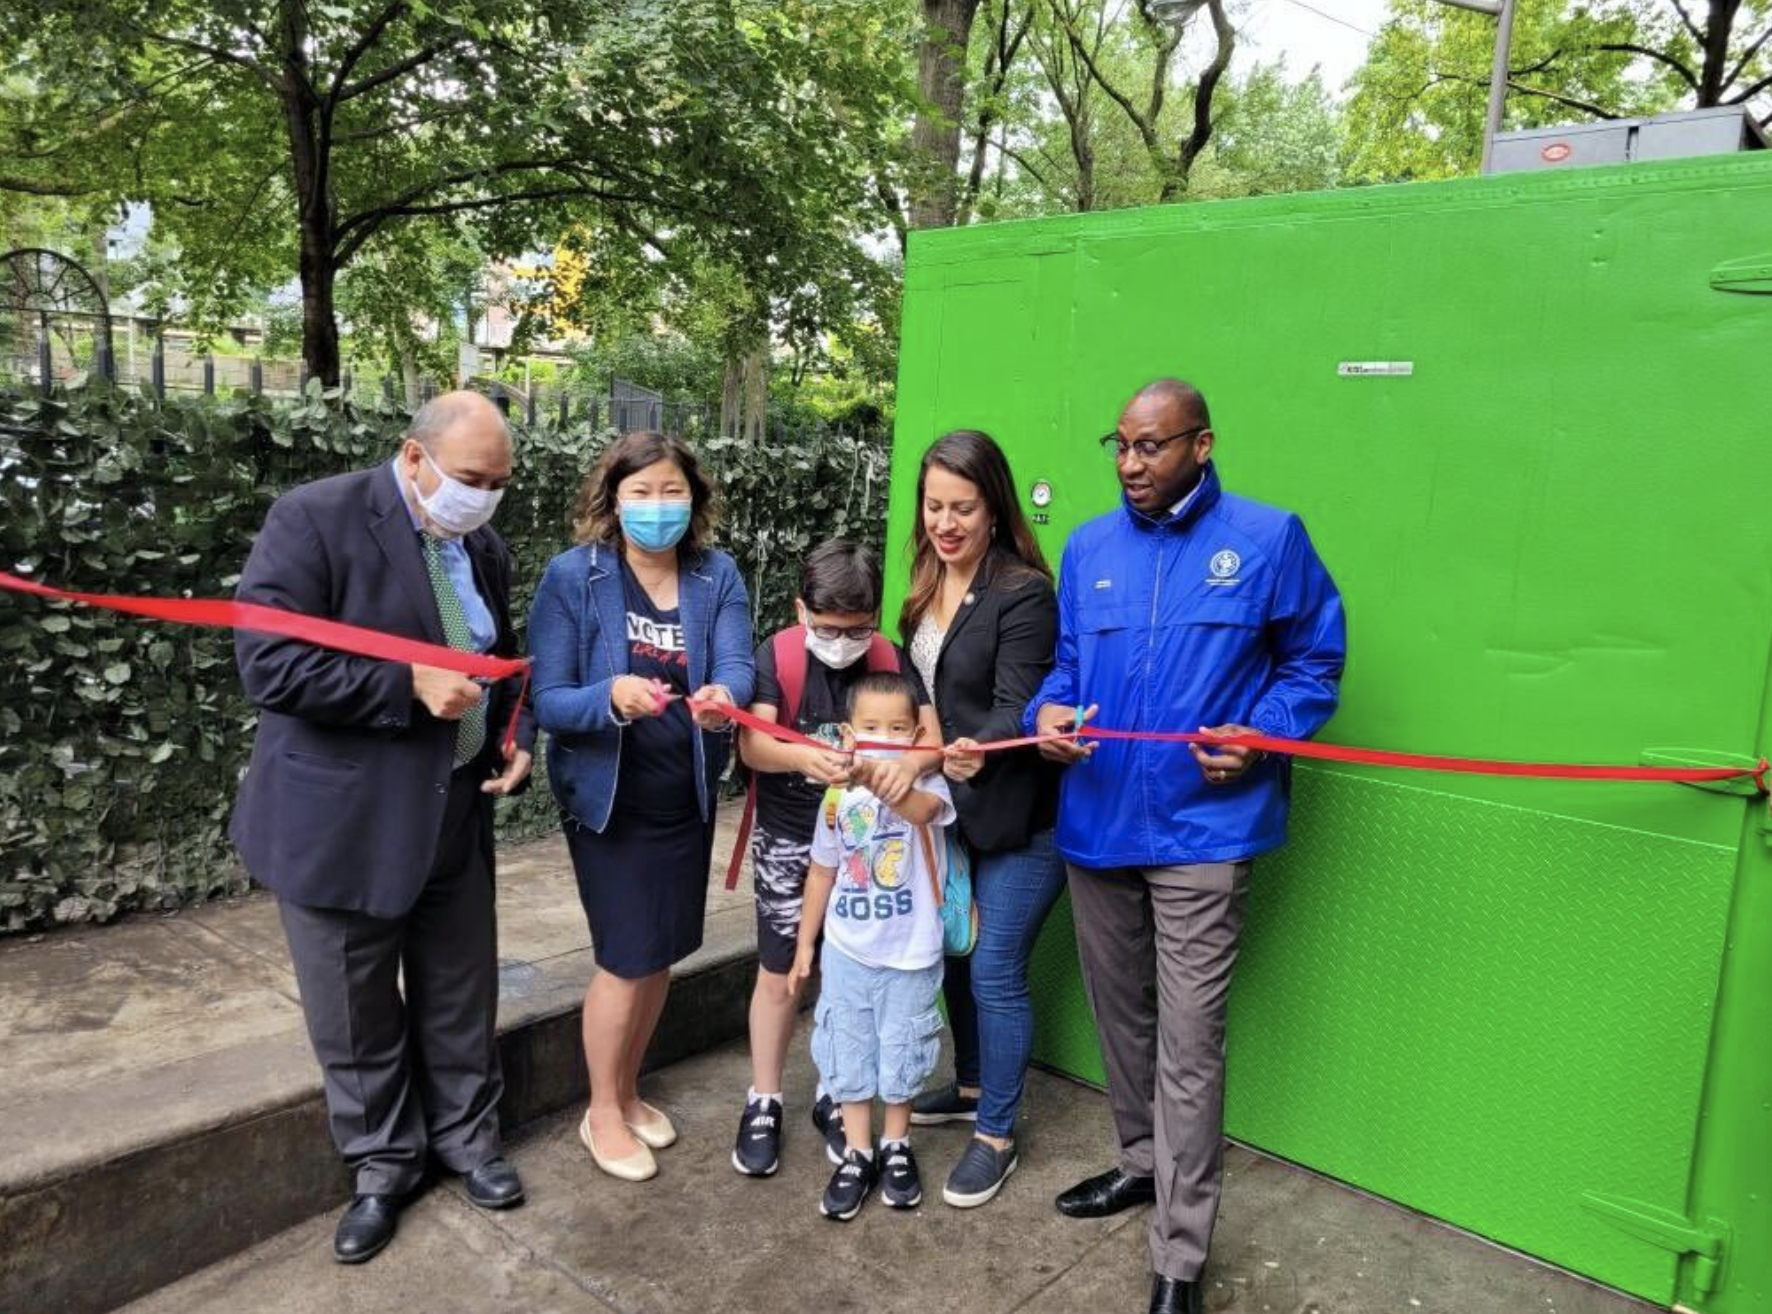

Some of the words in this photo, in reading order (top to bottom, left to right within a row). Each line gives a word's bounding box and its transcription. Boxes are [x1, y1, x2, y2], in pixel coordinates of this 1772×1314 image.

[627, 614, 685, 648] VOTE
[835, 888, 913, 921] BOSS
[750, 1116, 775, 1128] AIR
